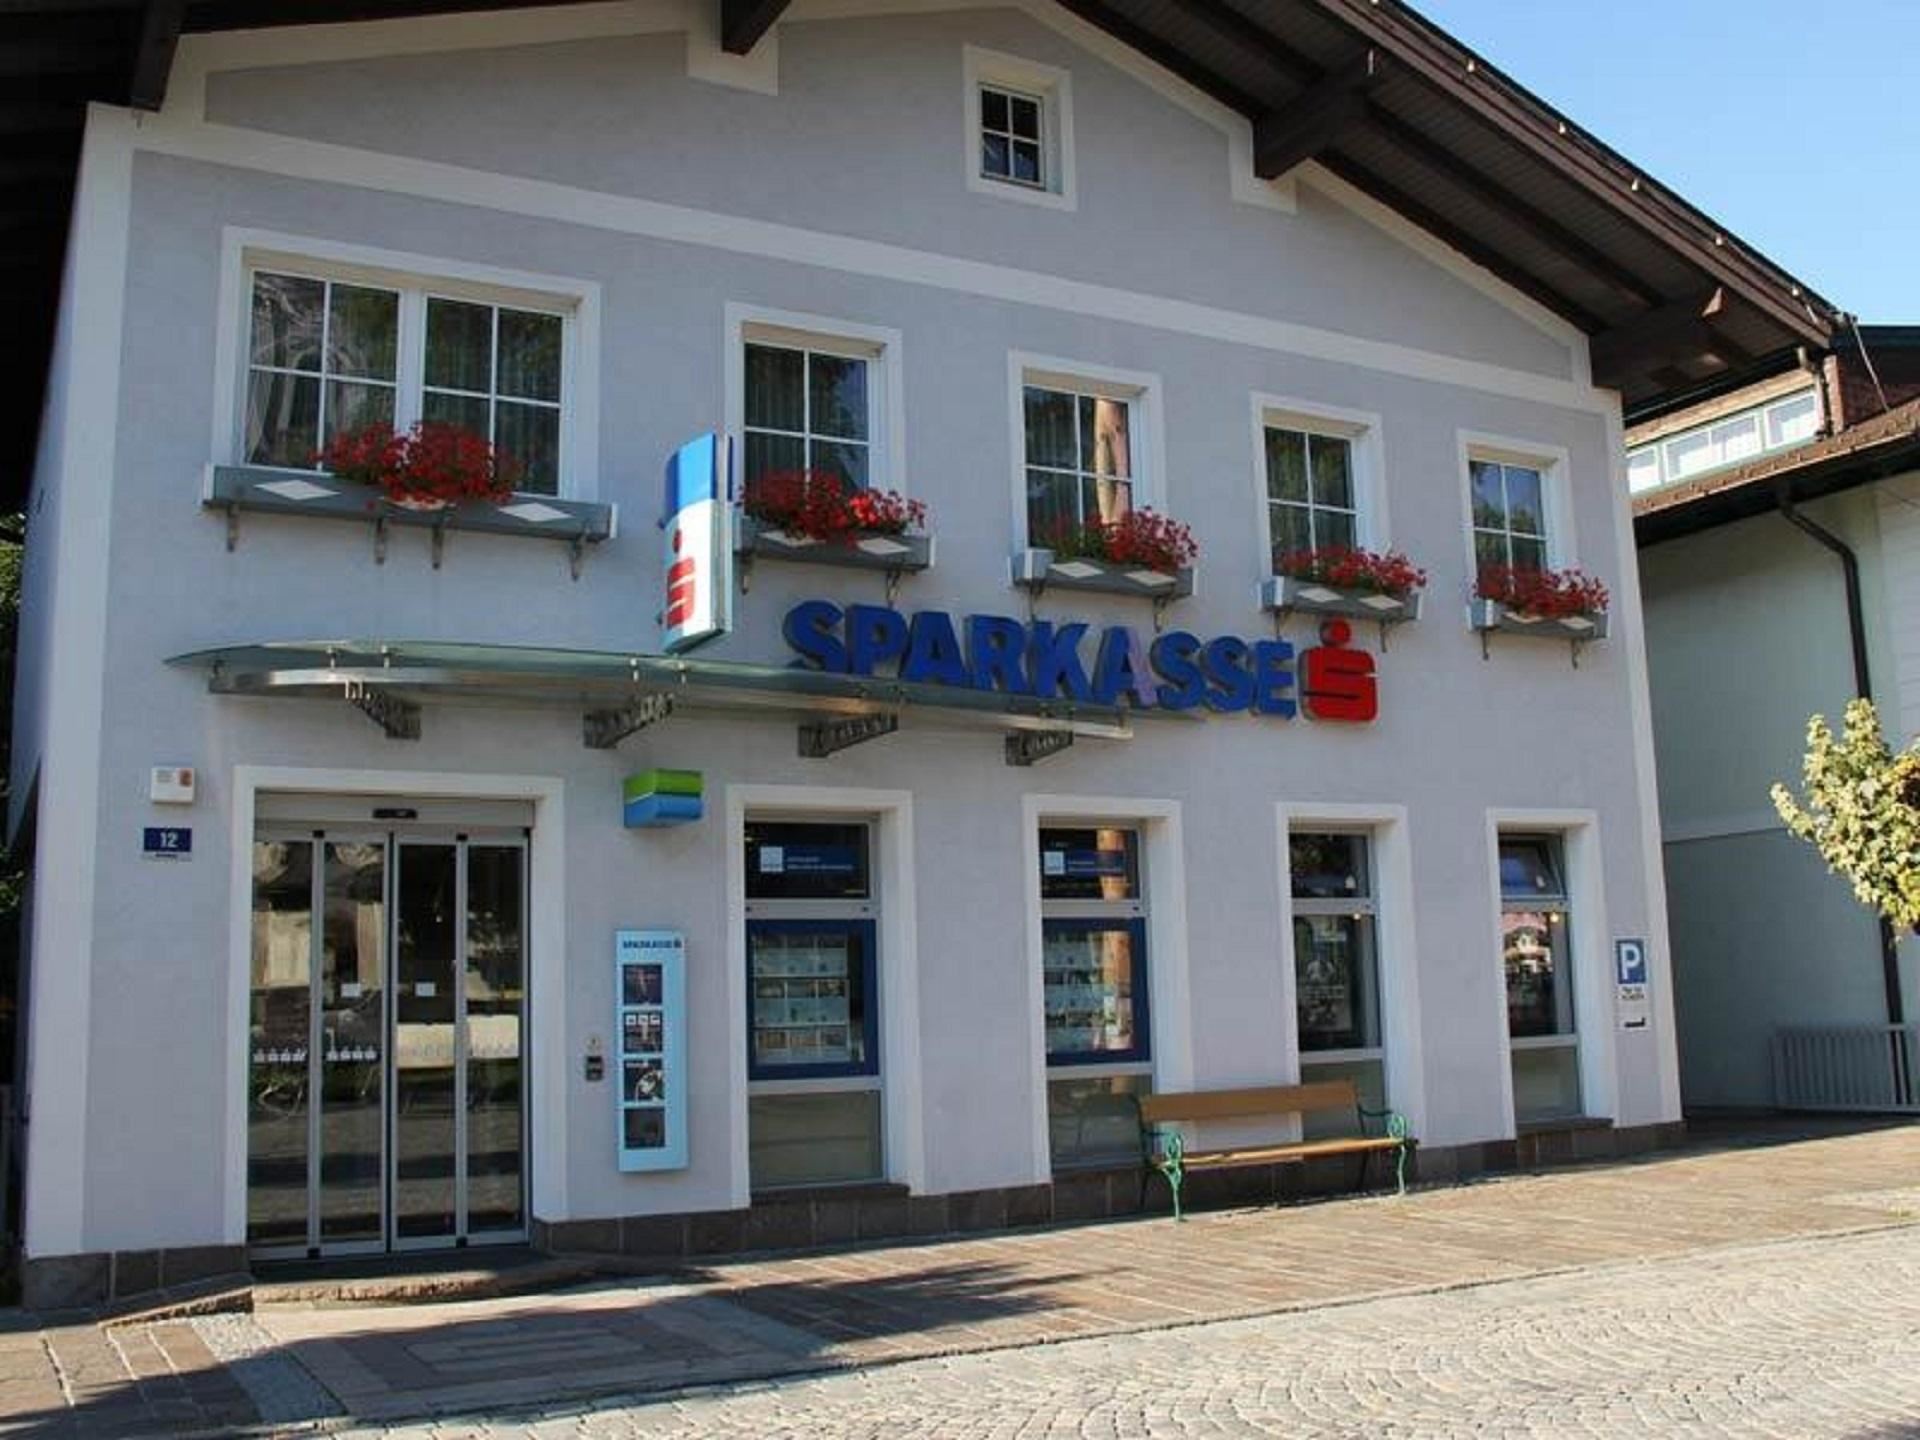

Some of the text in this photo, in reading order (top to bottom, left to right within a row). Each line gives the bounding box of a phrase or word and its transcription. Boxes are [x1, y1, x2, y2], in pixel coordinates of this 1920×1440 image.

[782, 600, 1297, 720] SPARKASSE
[160, 831, 179, 849] 12
[1620, 942, 1641, 980] P
